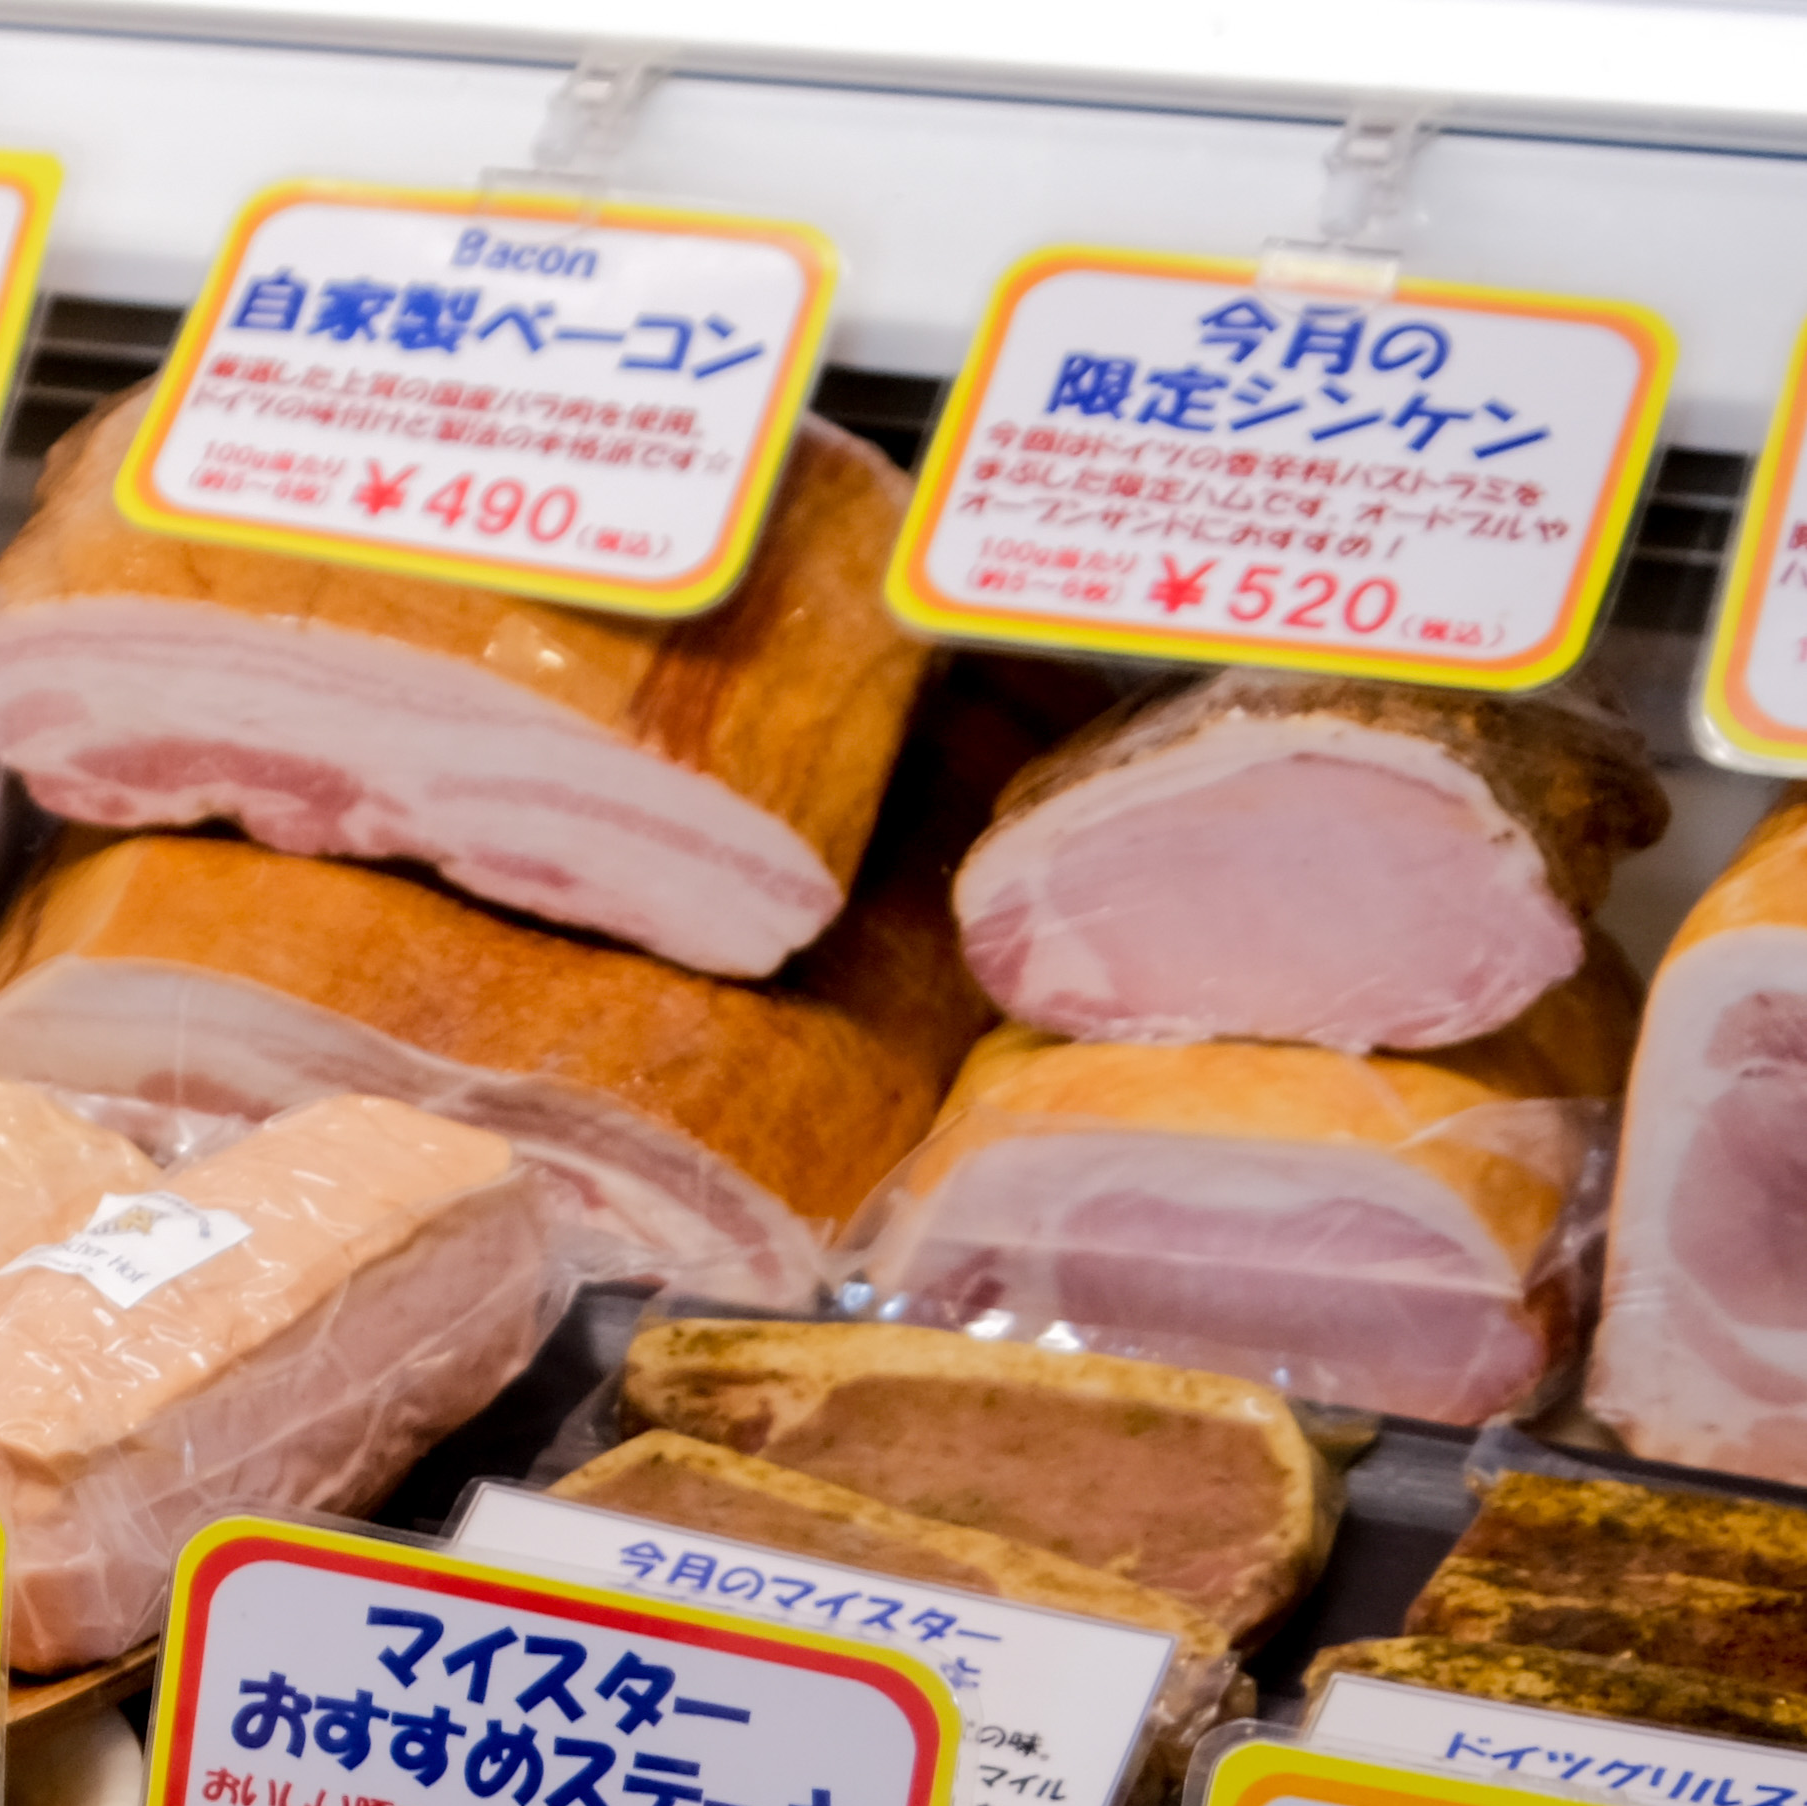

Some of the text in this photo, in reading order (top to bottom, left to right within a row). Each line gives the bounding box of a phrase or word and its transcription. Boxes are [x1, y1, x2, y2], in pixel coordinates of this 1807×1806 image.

[451, 228, 600, 280] Bacon
[231, 269, 765, 381] 自家製ベーコン
[1200, 295, 1451, 380] 今月の
[1044, 352, 1552, 460] 限定シンケン
[353, 458, 580, 544] ¥490
[1147, 554, 1401, 637] ¥520
[618, 1537, 1003, 1648] 今月のマイスター
[364, 1604, 753, 1739] マイスター
